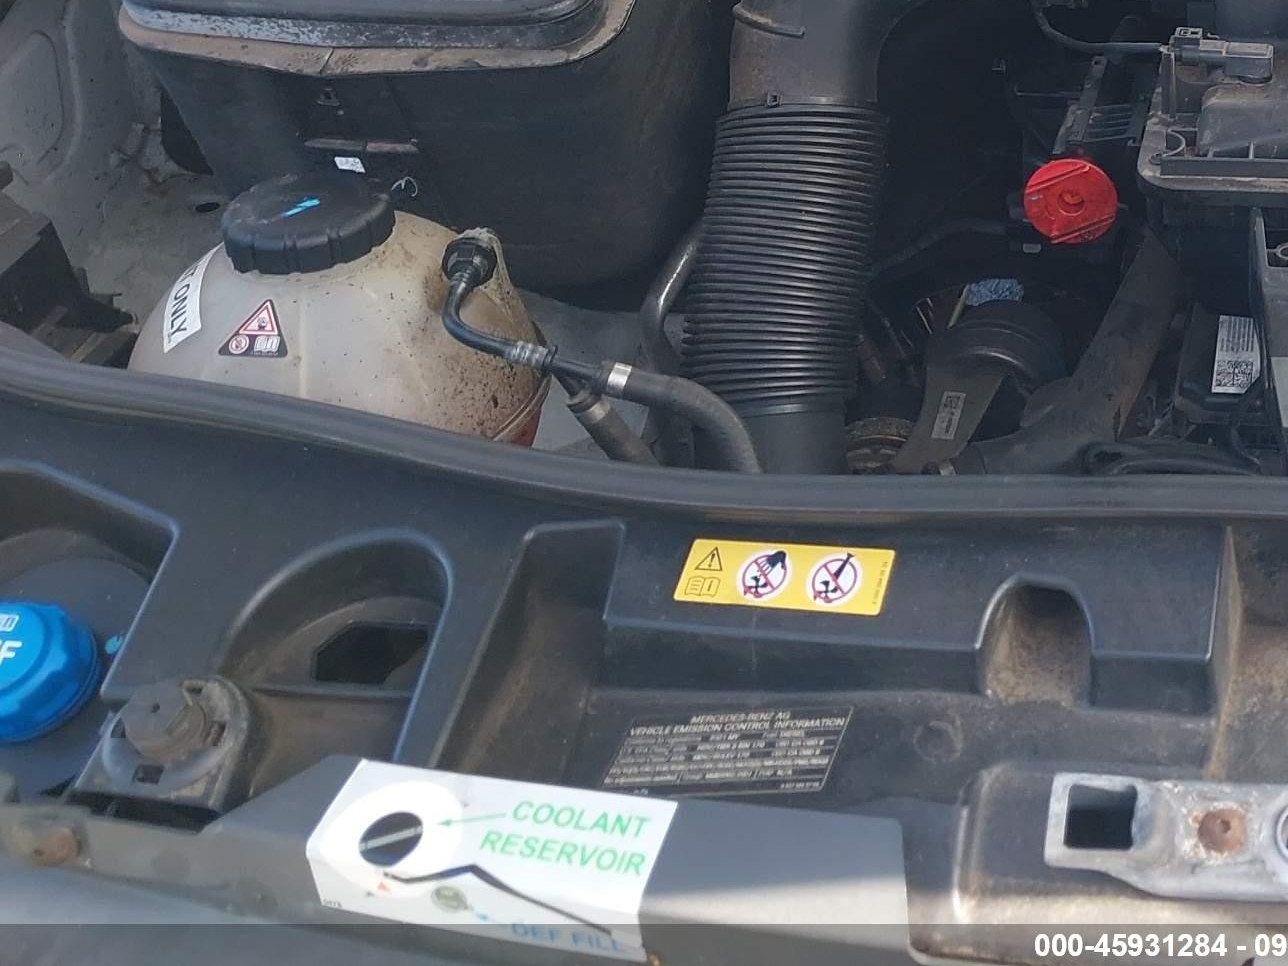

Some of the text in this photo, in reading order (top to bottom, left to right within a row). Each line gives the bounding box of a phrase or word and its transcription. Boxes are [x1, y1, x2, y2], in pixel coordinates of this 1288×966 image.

[170, 283, 190, 337] ONLY
[723, 719, 770, 732] CONTROL
[773, 716, 846, 730] INFORMATION
[513, 800, 653, 840] COOLANT
[480, 830, 647, 877] RESERVOIR
